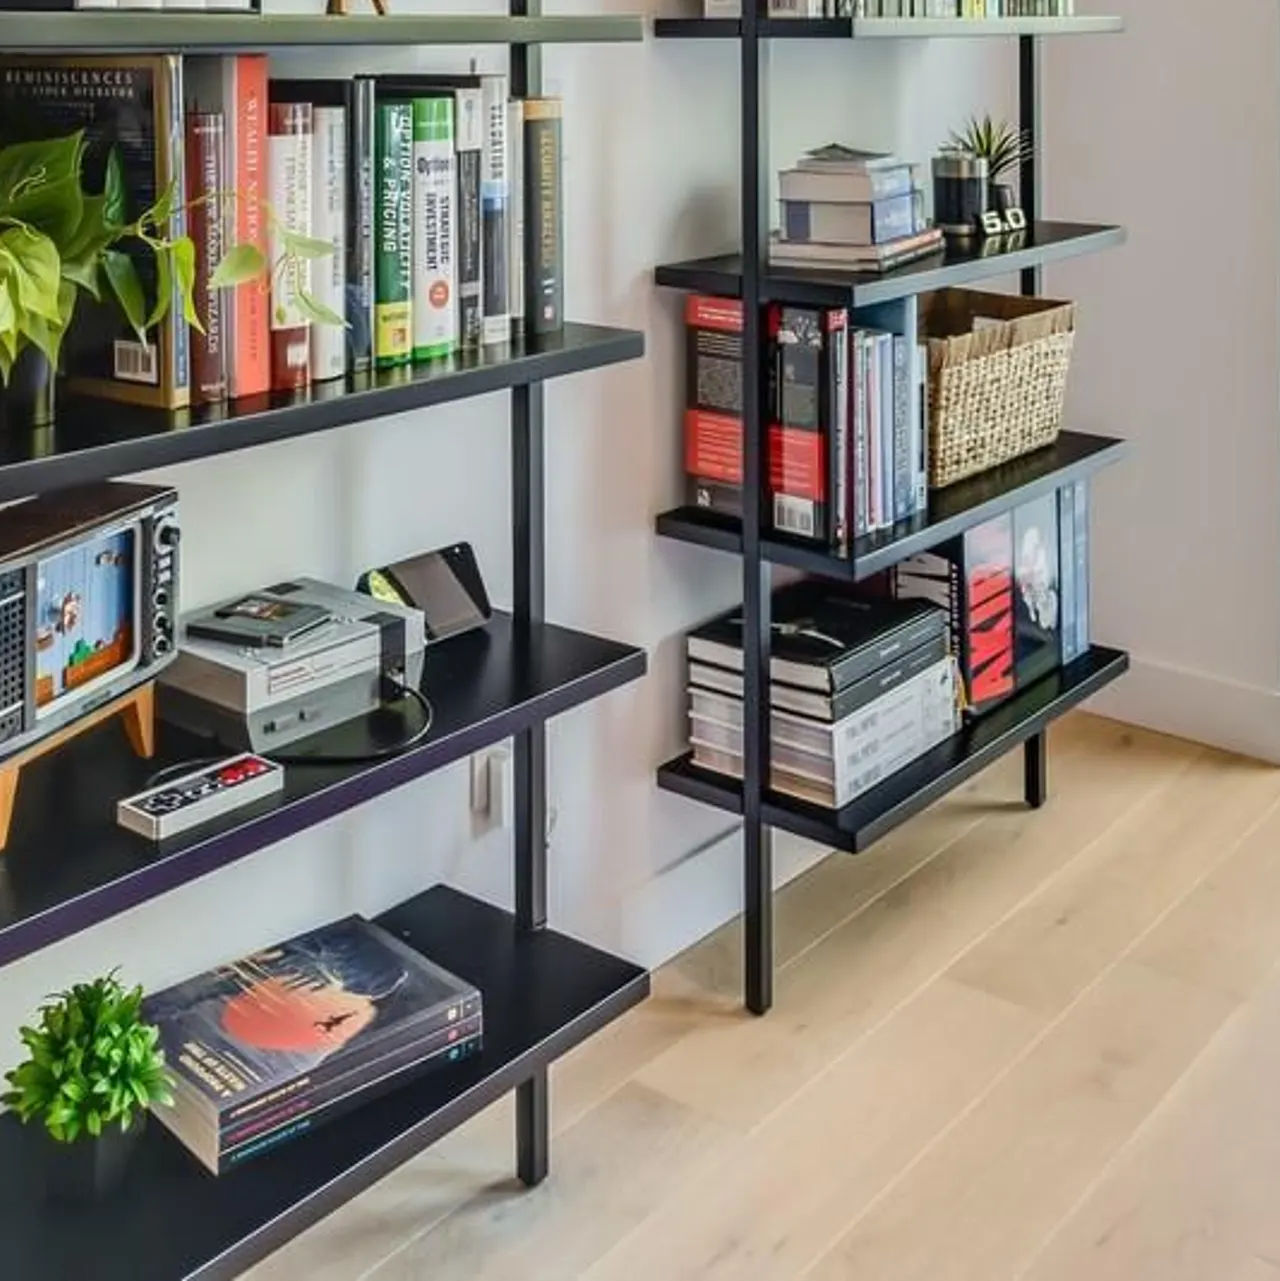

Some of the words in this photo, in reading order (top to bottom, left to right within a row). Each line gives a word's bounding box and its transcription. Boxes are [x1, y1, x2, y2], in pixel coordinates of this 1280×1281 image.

[246, 96, 258, 172] WEALTH
[383, 156, 396, 170] &
[246, 178, 258, 244] NATION
[286, 157, 297, 231] FINANCIA
[383, 178, 397, 253] PRICING
[425, 192, 438, 271] INVESTMENT
